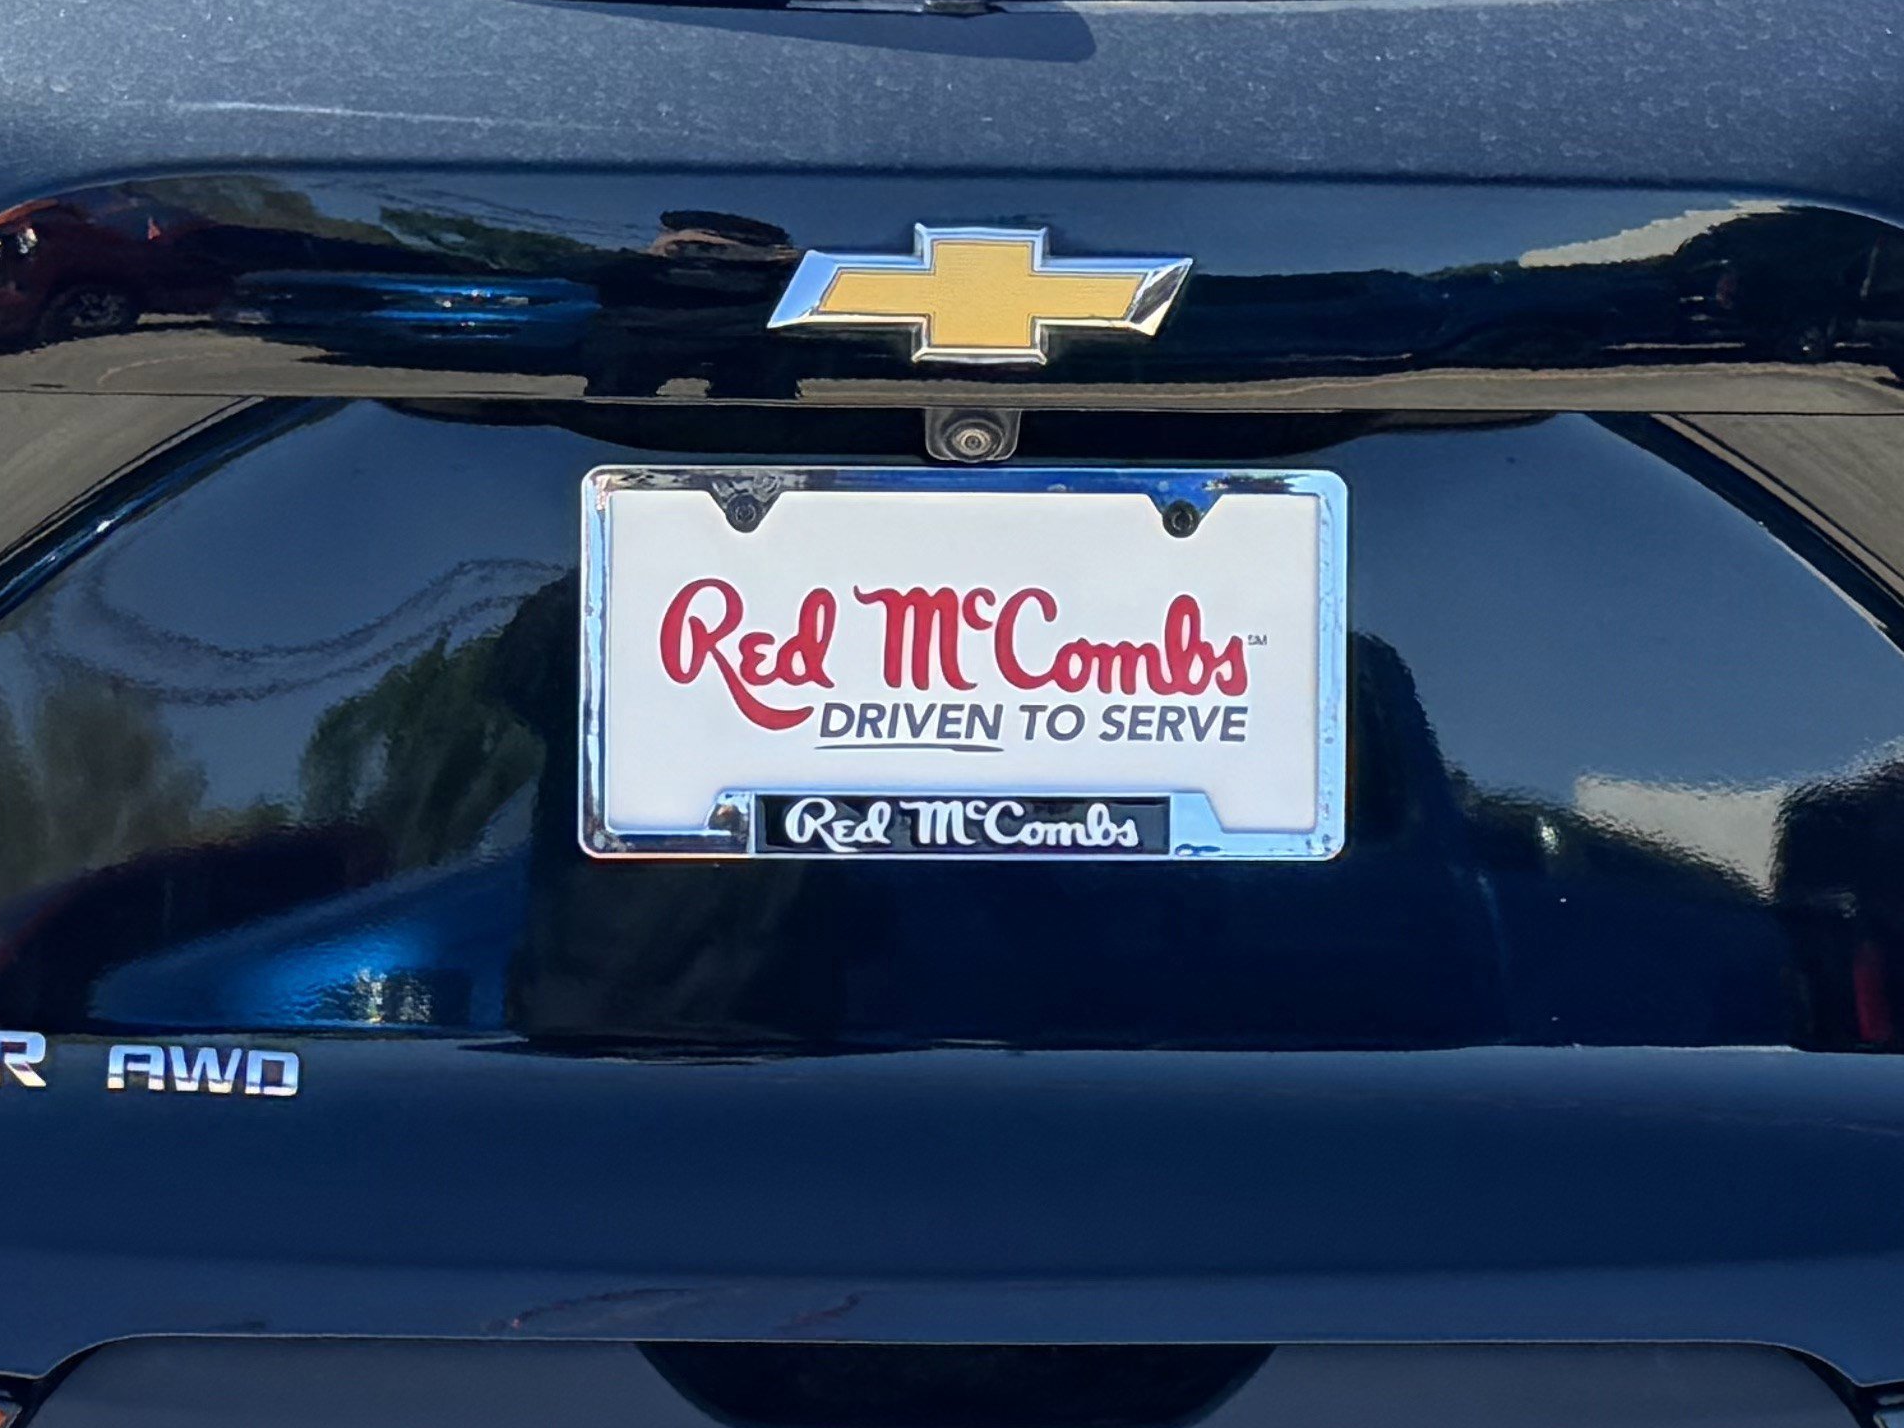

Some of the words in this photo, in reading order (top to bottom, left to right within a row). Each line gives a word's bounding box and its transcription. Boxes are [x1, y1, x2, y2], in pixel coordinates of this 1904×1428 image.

[660, 578, 836, 731] Red
[853, 584, 1248, 697] McCombs
[819, 702, 1004, 741] DRIVEN
[1019, 703, 1085, 741] TO
[1099, 704, 1249, 742] SERVE
[786, 796, 891, 853] Red
[899, 799, 1140, 848] McCombs
[106, 1043, 301, 1098] AWD
